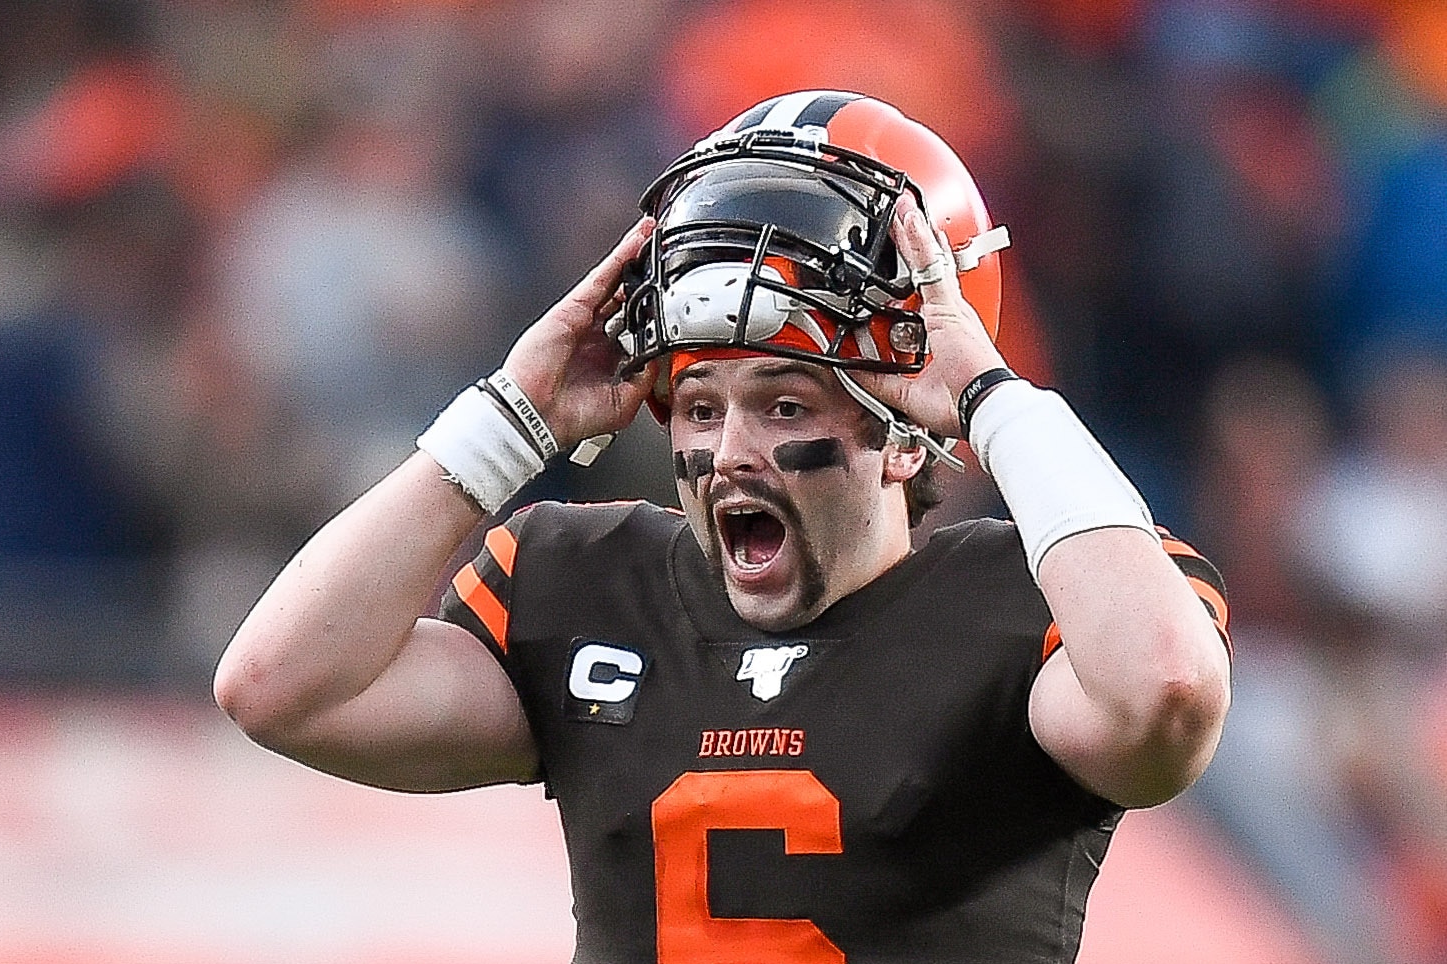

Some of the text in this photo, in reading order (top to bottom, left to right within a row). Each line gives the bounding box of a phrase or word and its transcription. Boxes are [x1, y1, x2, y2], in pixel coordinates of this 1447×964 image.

[514, 398, 549, 443] HUMBLE
[569, 644, 643, 702] C
[699, 729, 804, 756] BROWNS
